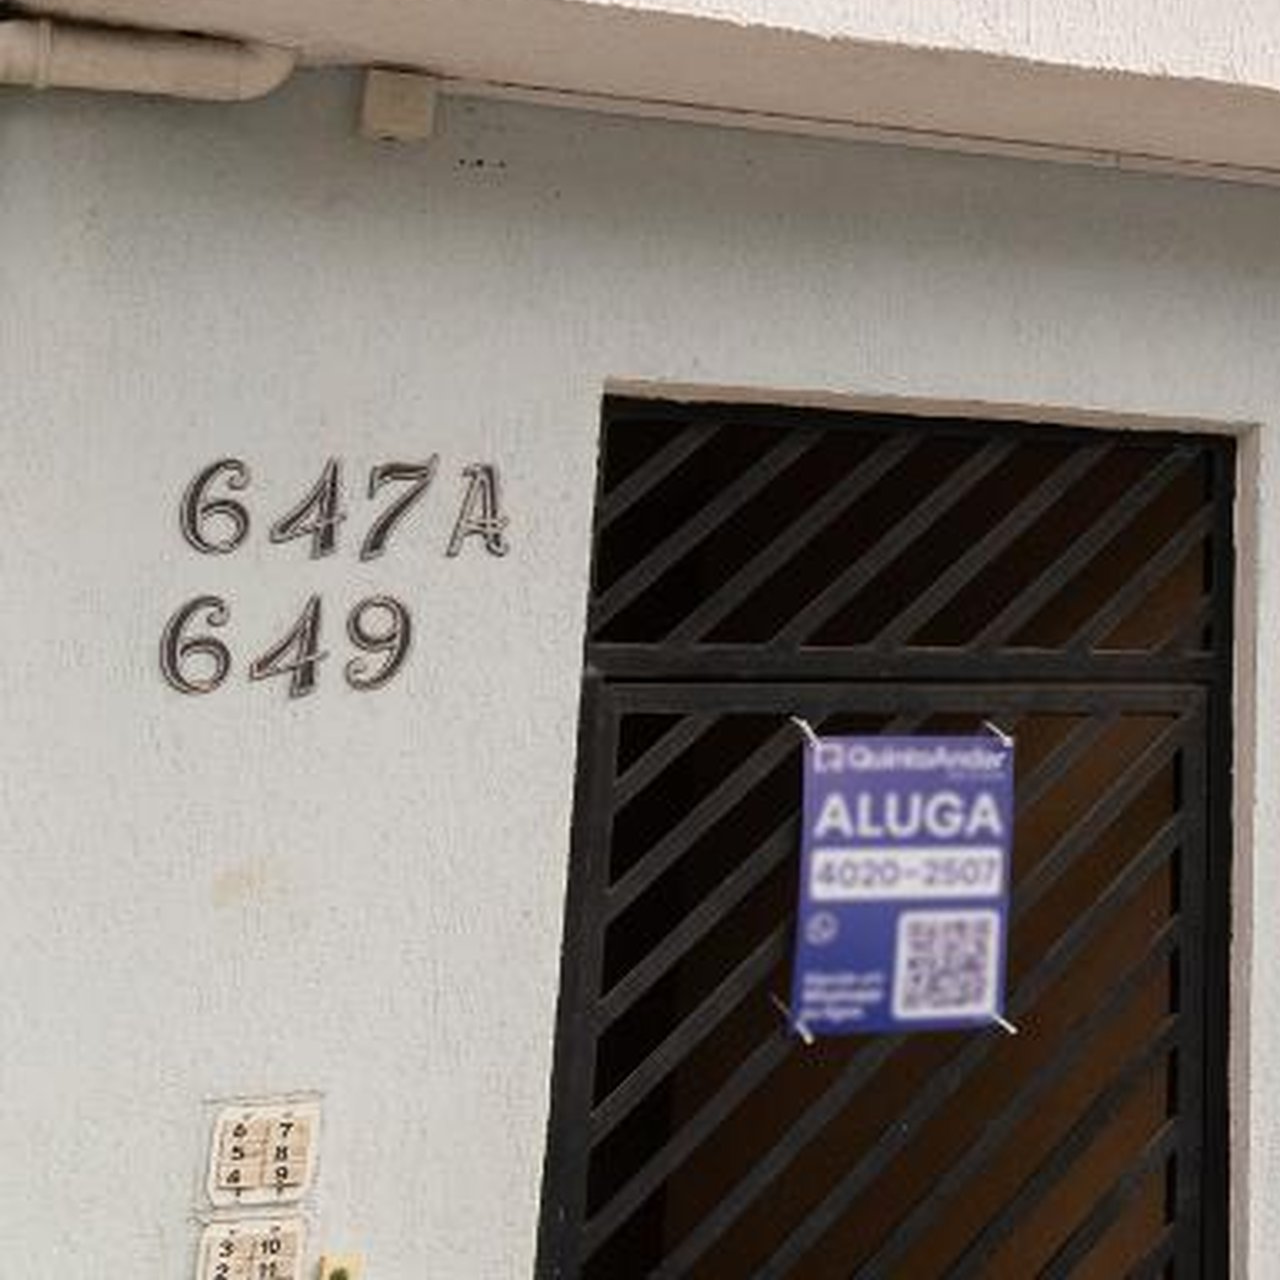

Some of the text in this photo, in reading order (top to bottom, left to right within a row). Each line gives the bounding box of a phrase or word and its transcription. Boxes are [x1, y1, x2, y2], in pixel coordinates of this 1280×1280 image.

[160, 594, 414, 698] 649
[813, 791, 1004, 839] ALUGA
[816, 856, 998, 889] 4020-2507
[279, 1121, 295, 1138] 7
[275, 1165, 289, 1180] 9
[218, 1238, 281, 1258] 3 10
